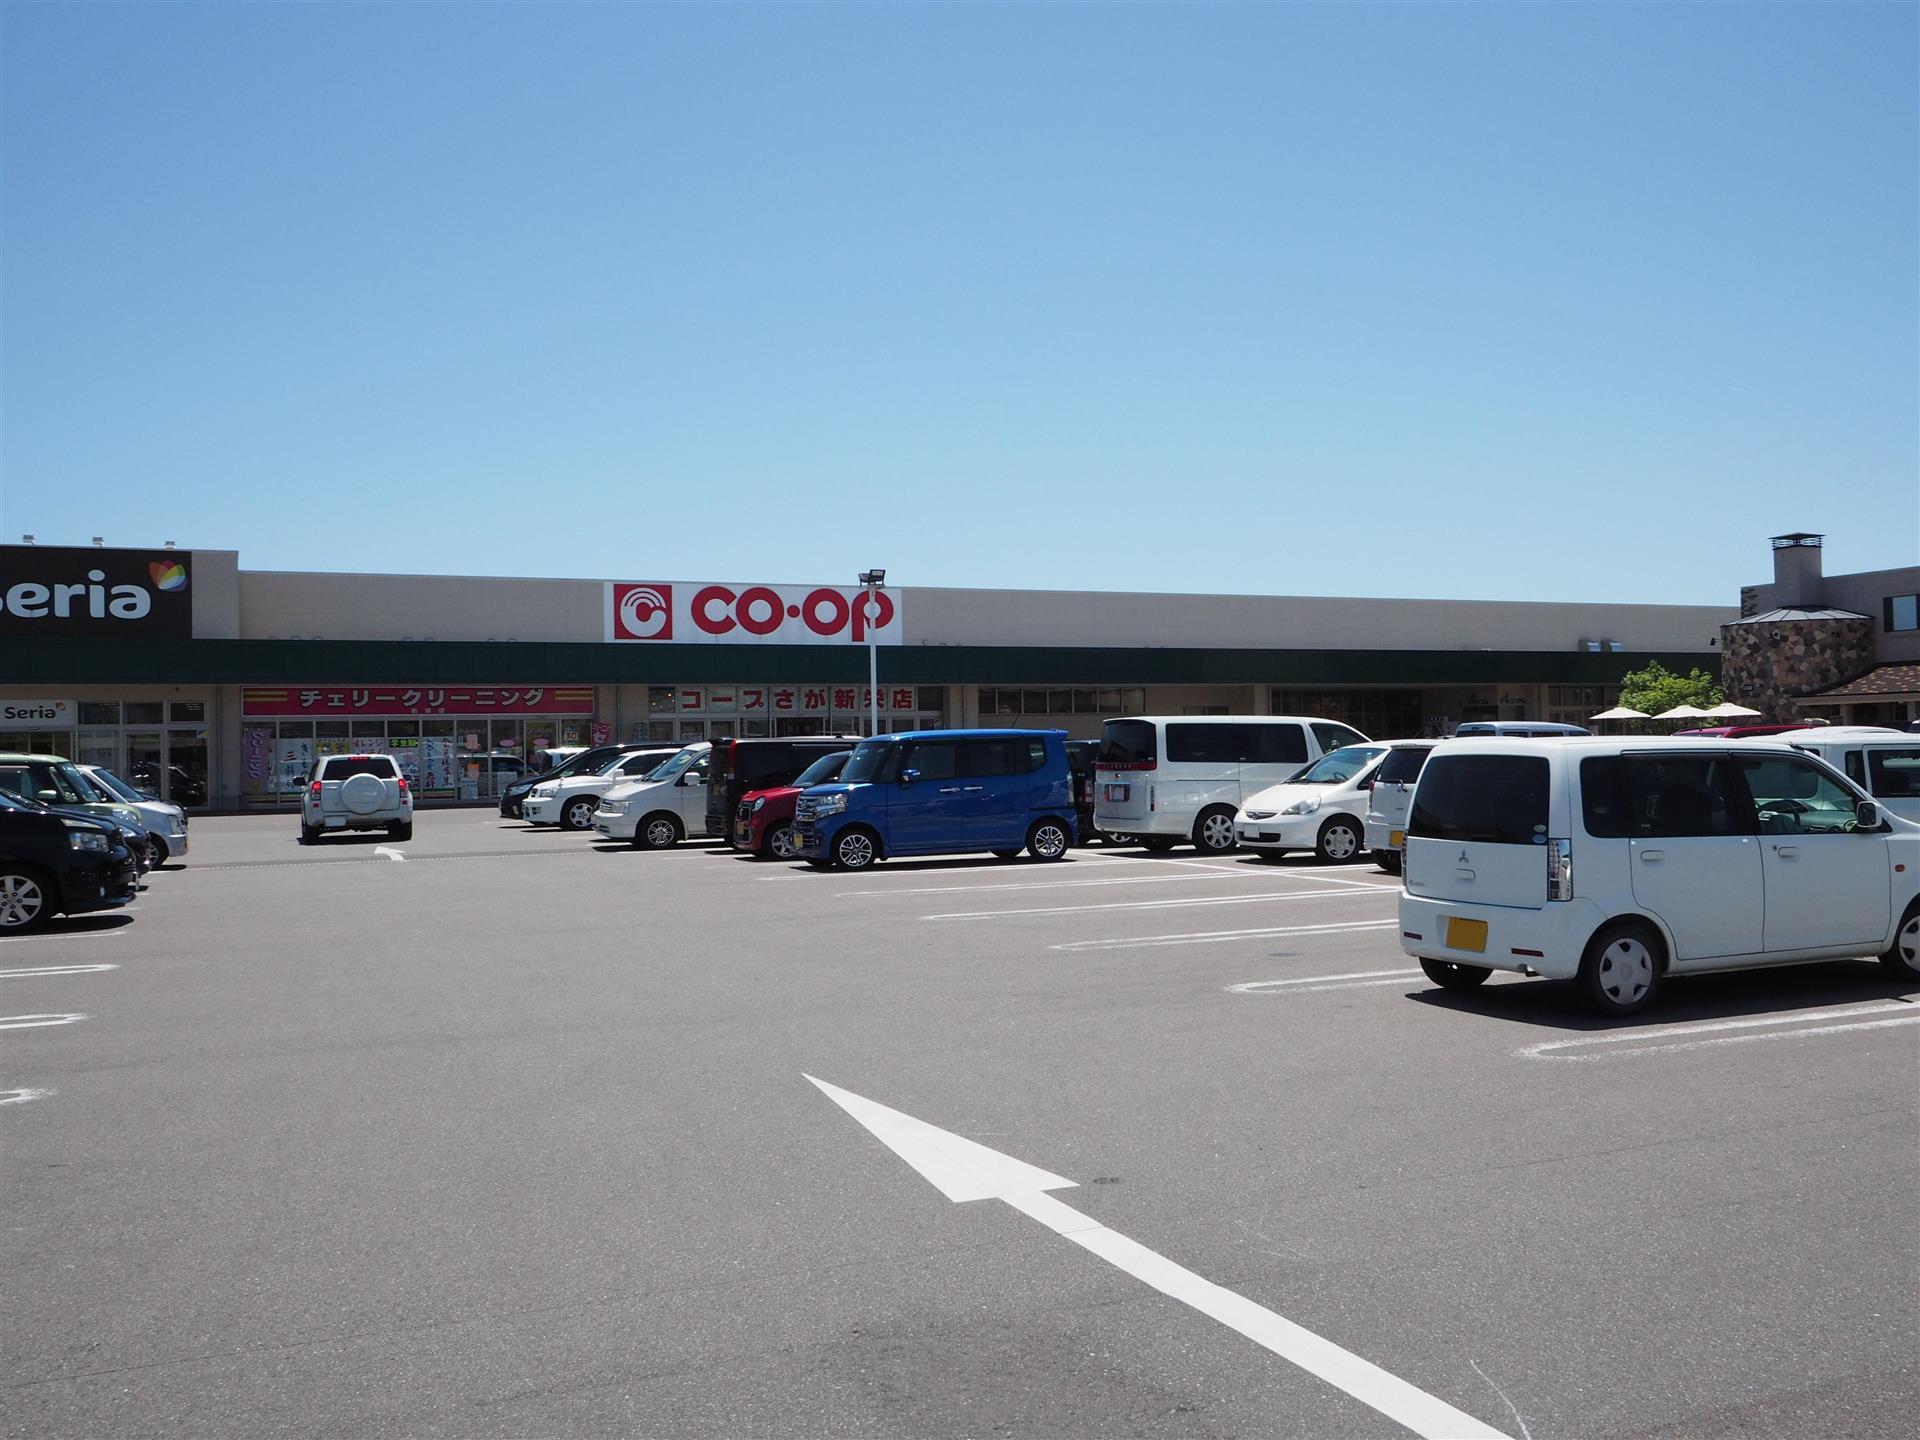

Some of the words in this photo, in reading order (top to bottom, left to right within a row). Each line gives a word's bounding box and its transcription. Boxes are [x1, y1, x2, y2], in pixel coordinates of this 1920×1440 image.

[0, 569, 151, 619] eria
[300, 689, 544, 707] チェリークリーニング
[682, 688, 913, 710] コープさが新栄店
[4, 705, 56, 719] Seria
